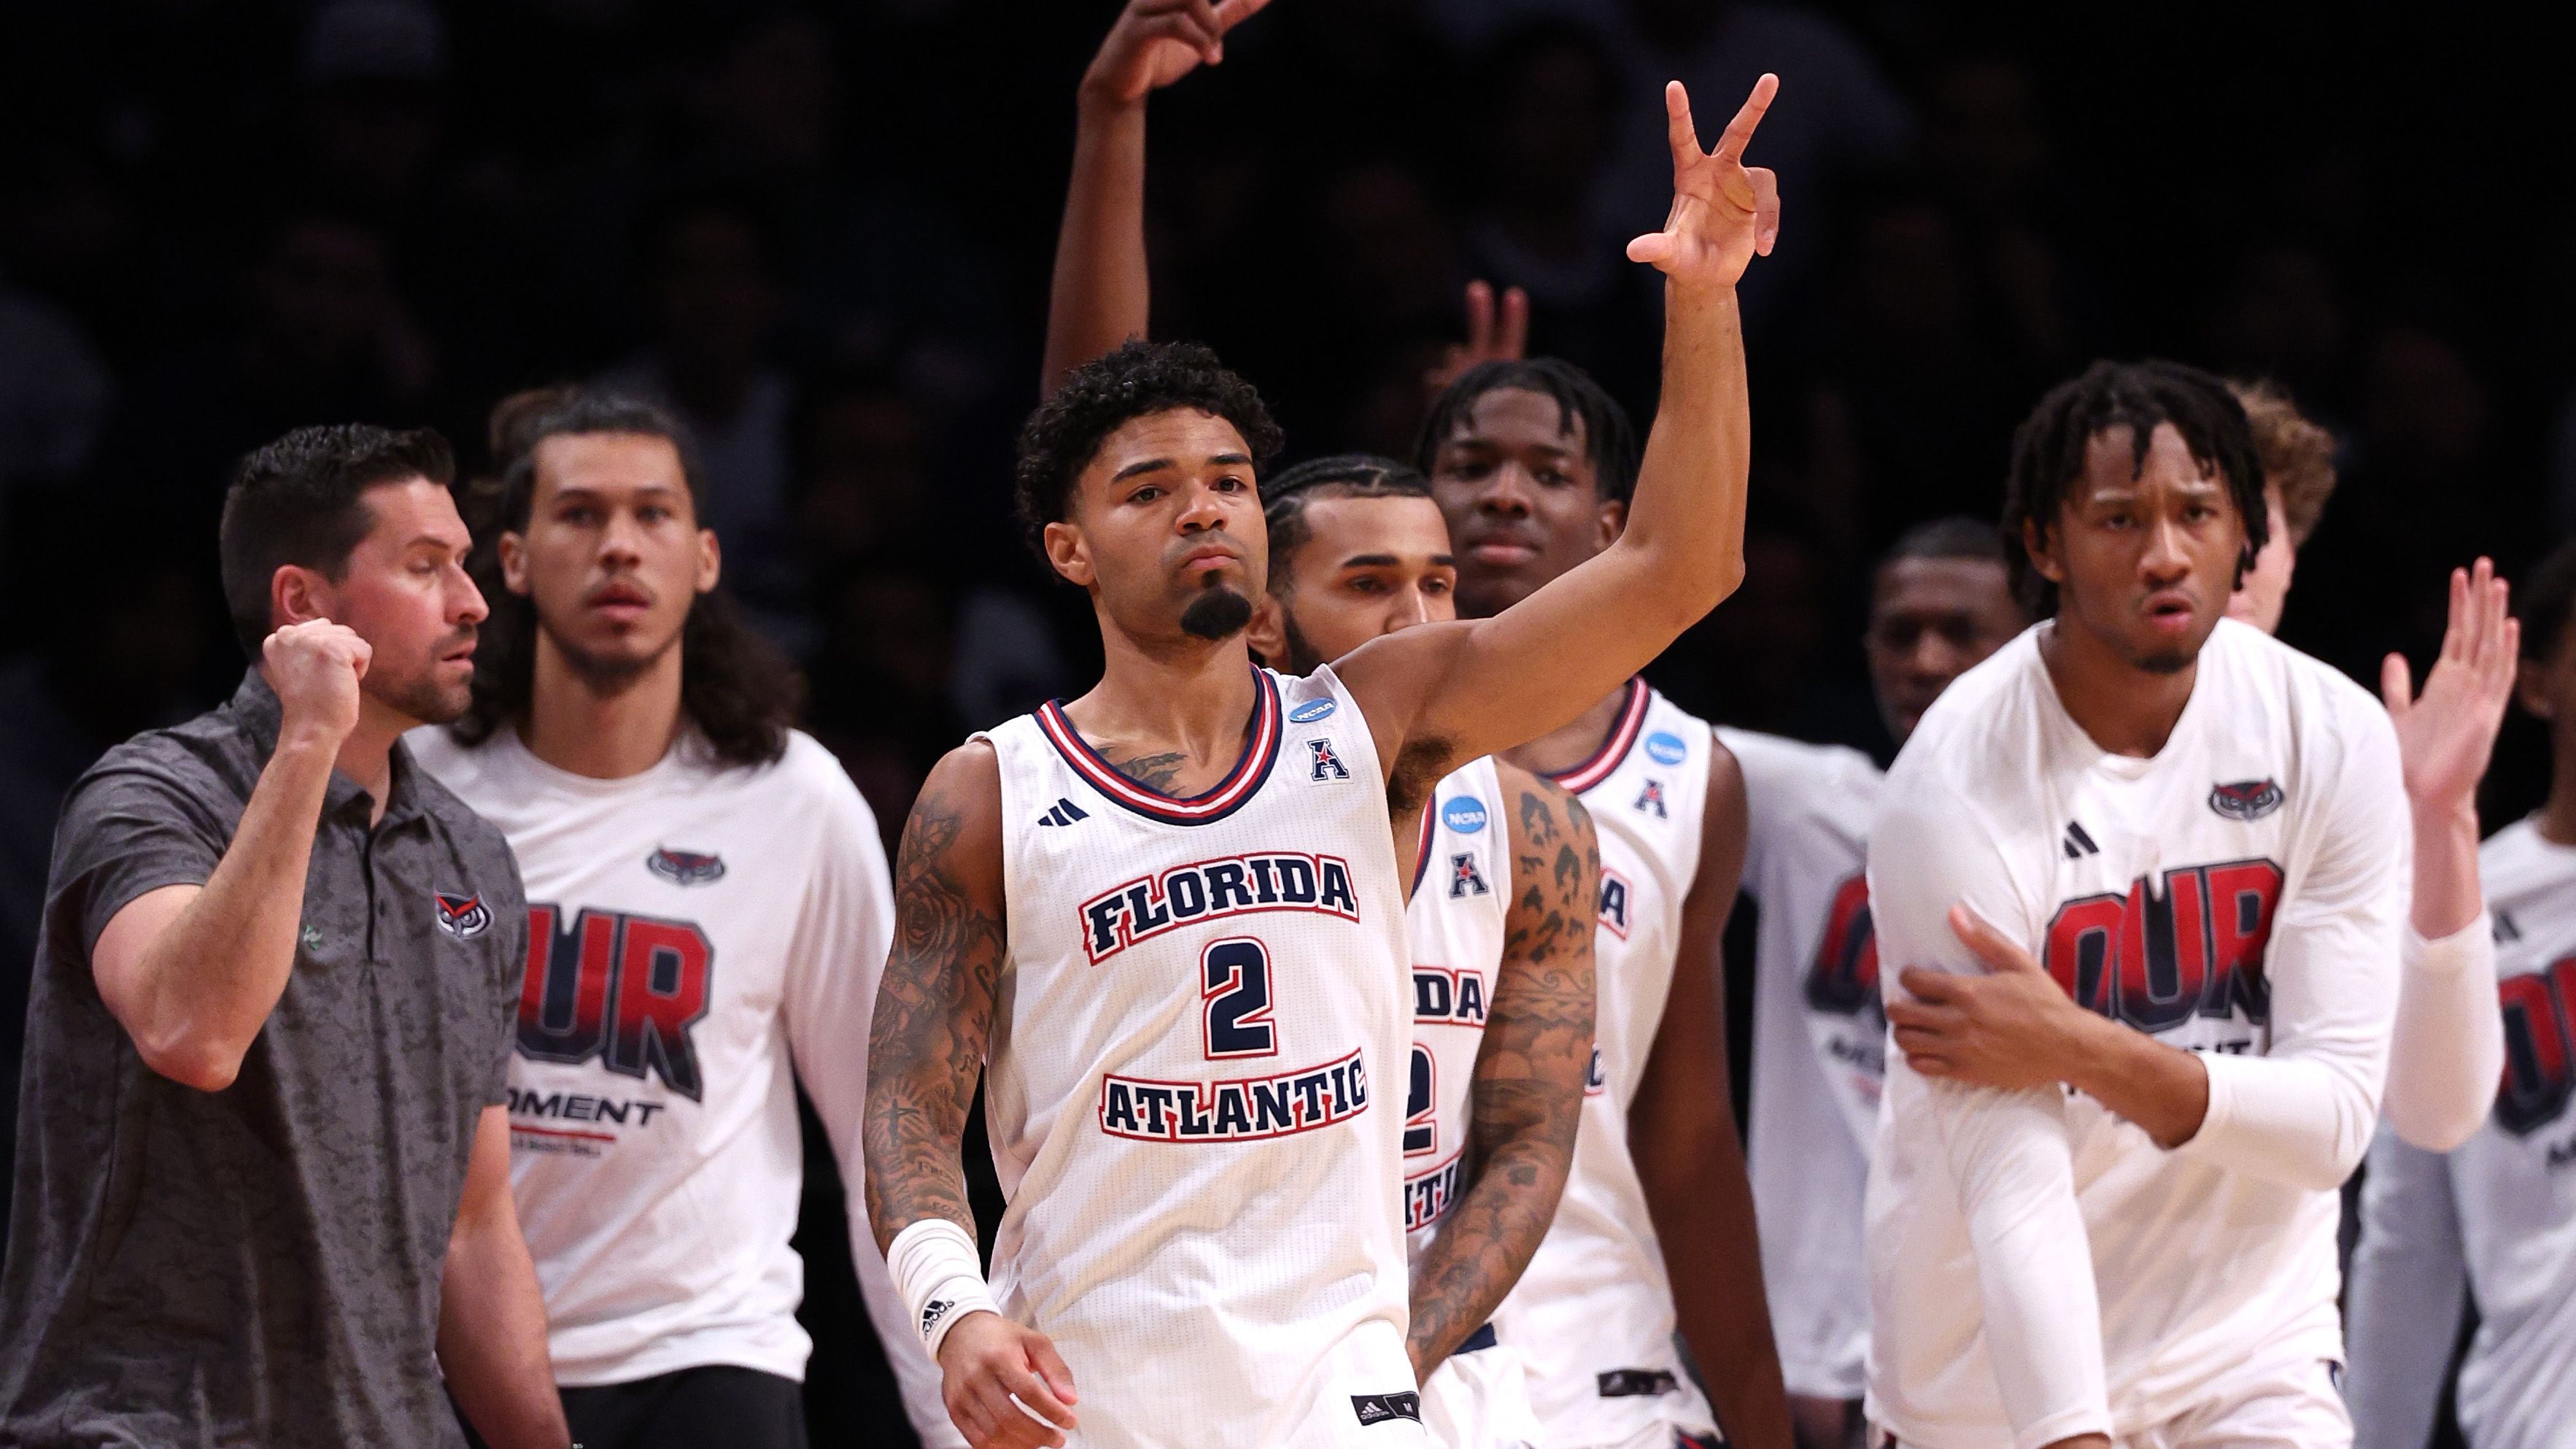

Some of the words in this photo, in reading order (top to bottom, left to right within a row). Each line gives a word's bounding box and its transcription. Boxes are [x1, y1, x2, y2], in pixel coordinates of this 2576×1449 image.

[1296, 702, 1334, 720] NCAA
[1448, 811, 1485, 825] NCAA
[1079, 851, 1360, 966] FLORIDA
[2043, 858, 2284, 1033] OUR
[515, 903, 715, 1102] UR
[1200, 936, 1277, 1060] 2
[509, 1089, 665, 1127] MENT
[1099, 1048, 1369, 1143] ATLANTIC
